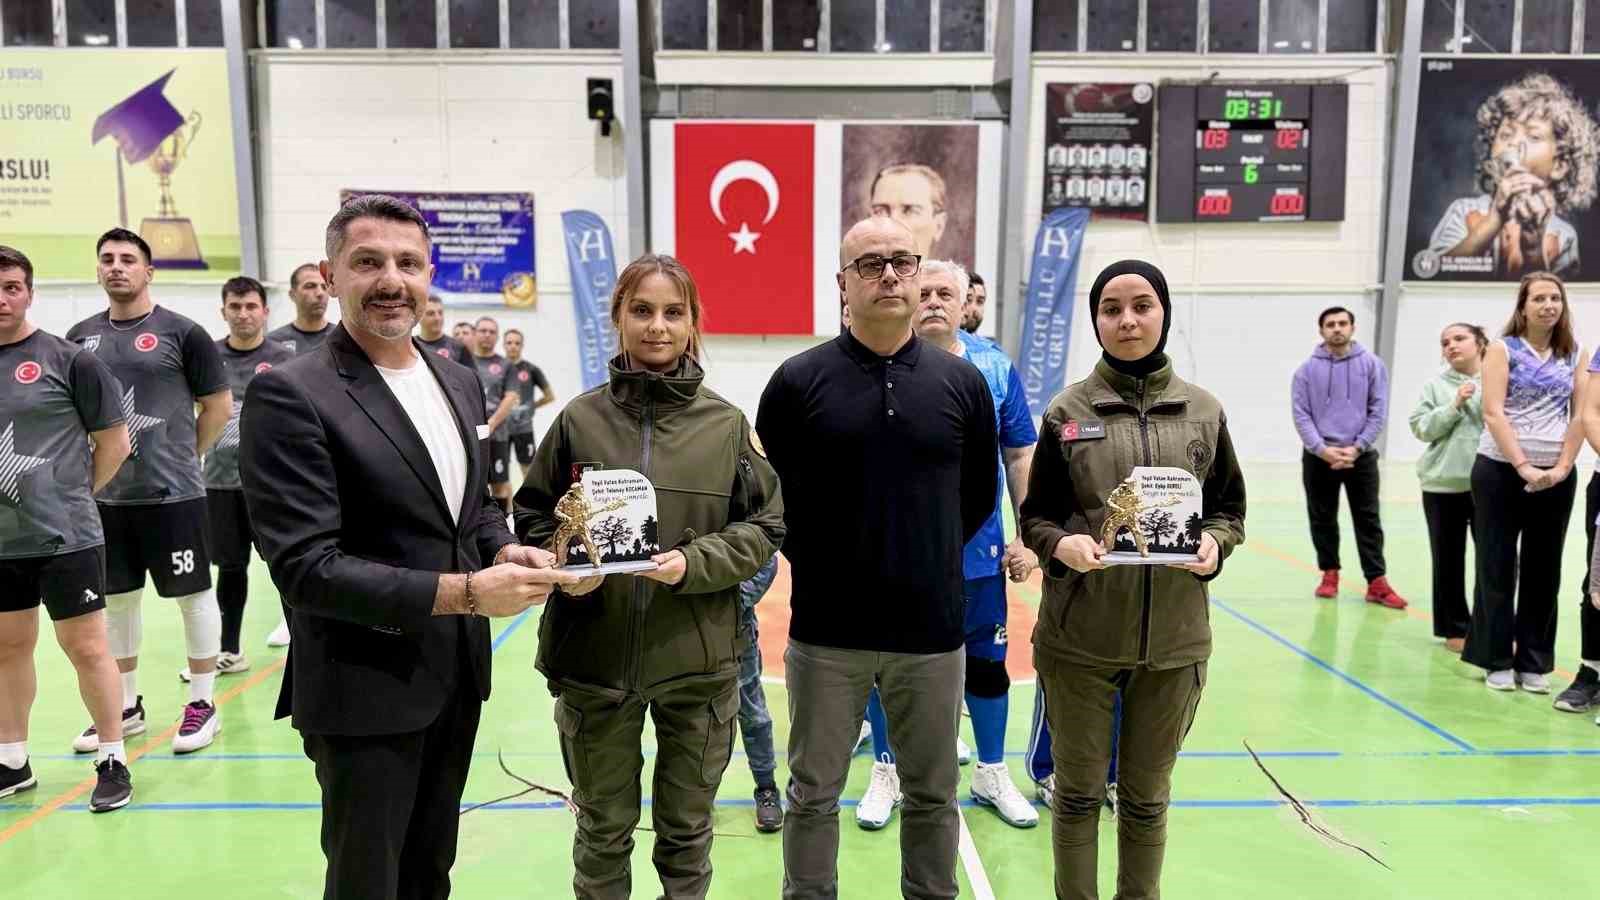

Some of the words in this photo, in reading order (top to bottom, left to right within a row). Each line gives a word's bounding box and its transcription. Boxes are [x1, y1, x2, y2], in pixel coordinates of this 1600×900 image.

[17, 104, 71, 120] SPORCU
[1224, 99, 1283, 120] 03:31
[1244, 165, 1258, 184] 6
[1048, 314, 1067, 369] GRUP
[171, 549, 195, 575] 58
